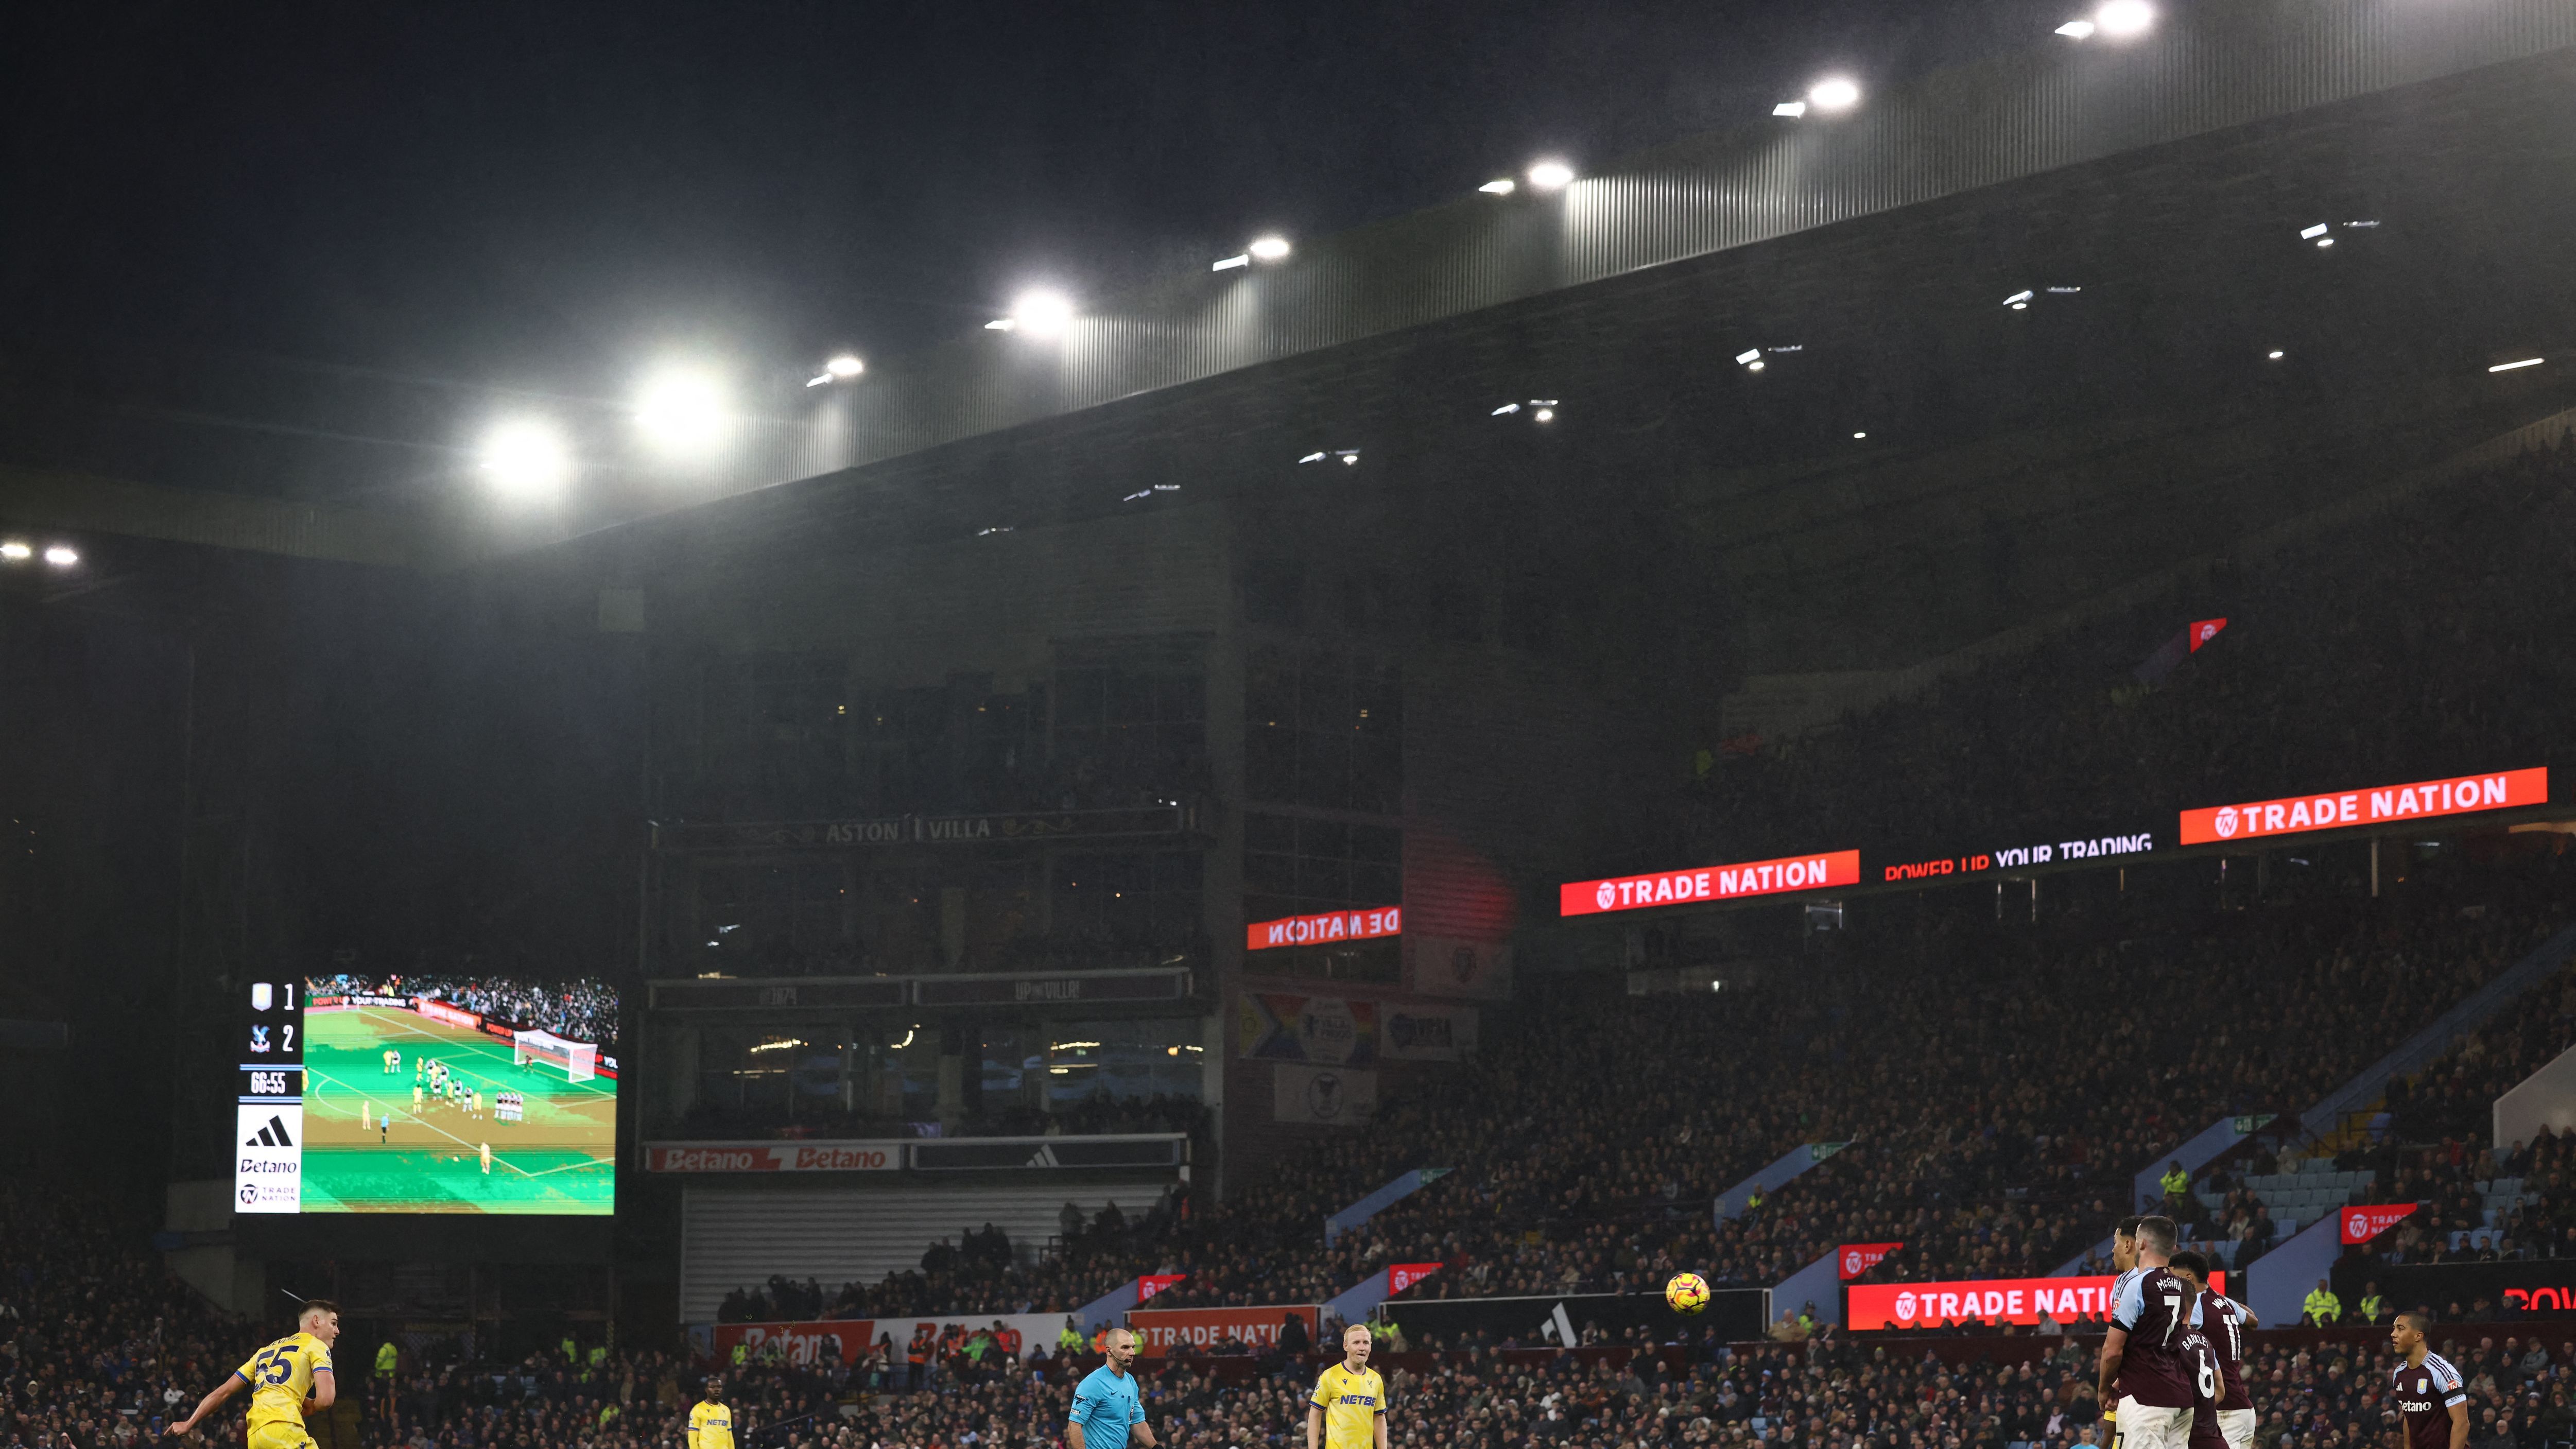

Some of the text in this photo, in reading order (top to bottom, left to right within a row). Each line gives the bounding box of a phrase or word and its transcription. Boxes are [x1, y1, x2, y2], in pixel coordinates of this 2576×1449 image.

[2243, 795, 2358, 833] TRADE
[2371, 777, 2505, 818] NATION
[826, 819, 990, 843] ASTON VILLA
[2059, 833, 2151, 859] TRADING
[1620, 873, 1709, 905] TRADE
[1720, 859, 1827, 894] NATION
[284, 983, 294, 1010] 1
[282, 1025, 293, 1051] 2
[251, 1072, 286, 1094] 66:55
[240, 1159, 297, 1173] Betano
[665, 1148, 886, 1169] Betano Betano
[1921, 1290, 2023, 1317] TRADE
[2035, 1287, 2113, 1313] NATI
[2164, 1296, 2181, 1346] 7
[1151, 1323, 1309, 1347] TRADE NATI
[2223, 1315, 2240, 1360] 11
[254, 1345, 300, 1392] 55
[2198, 1349, 2215, 1399] 6
